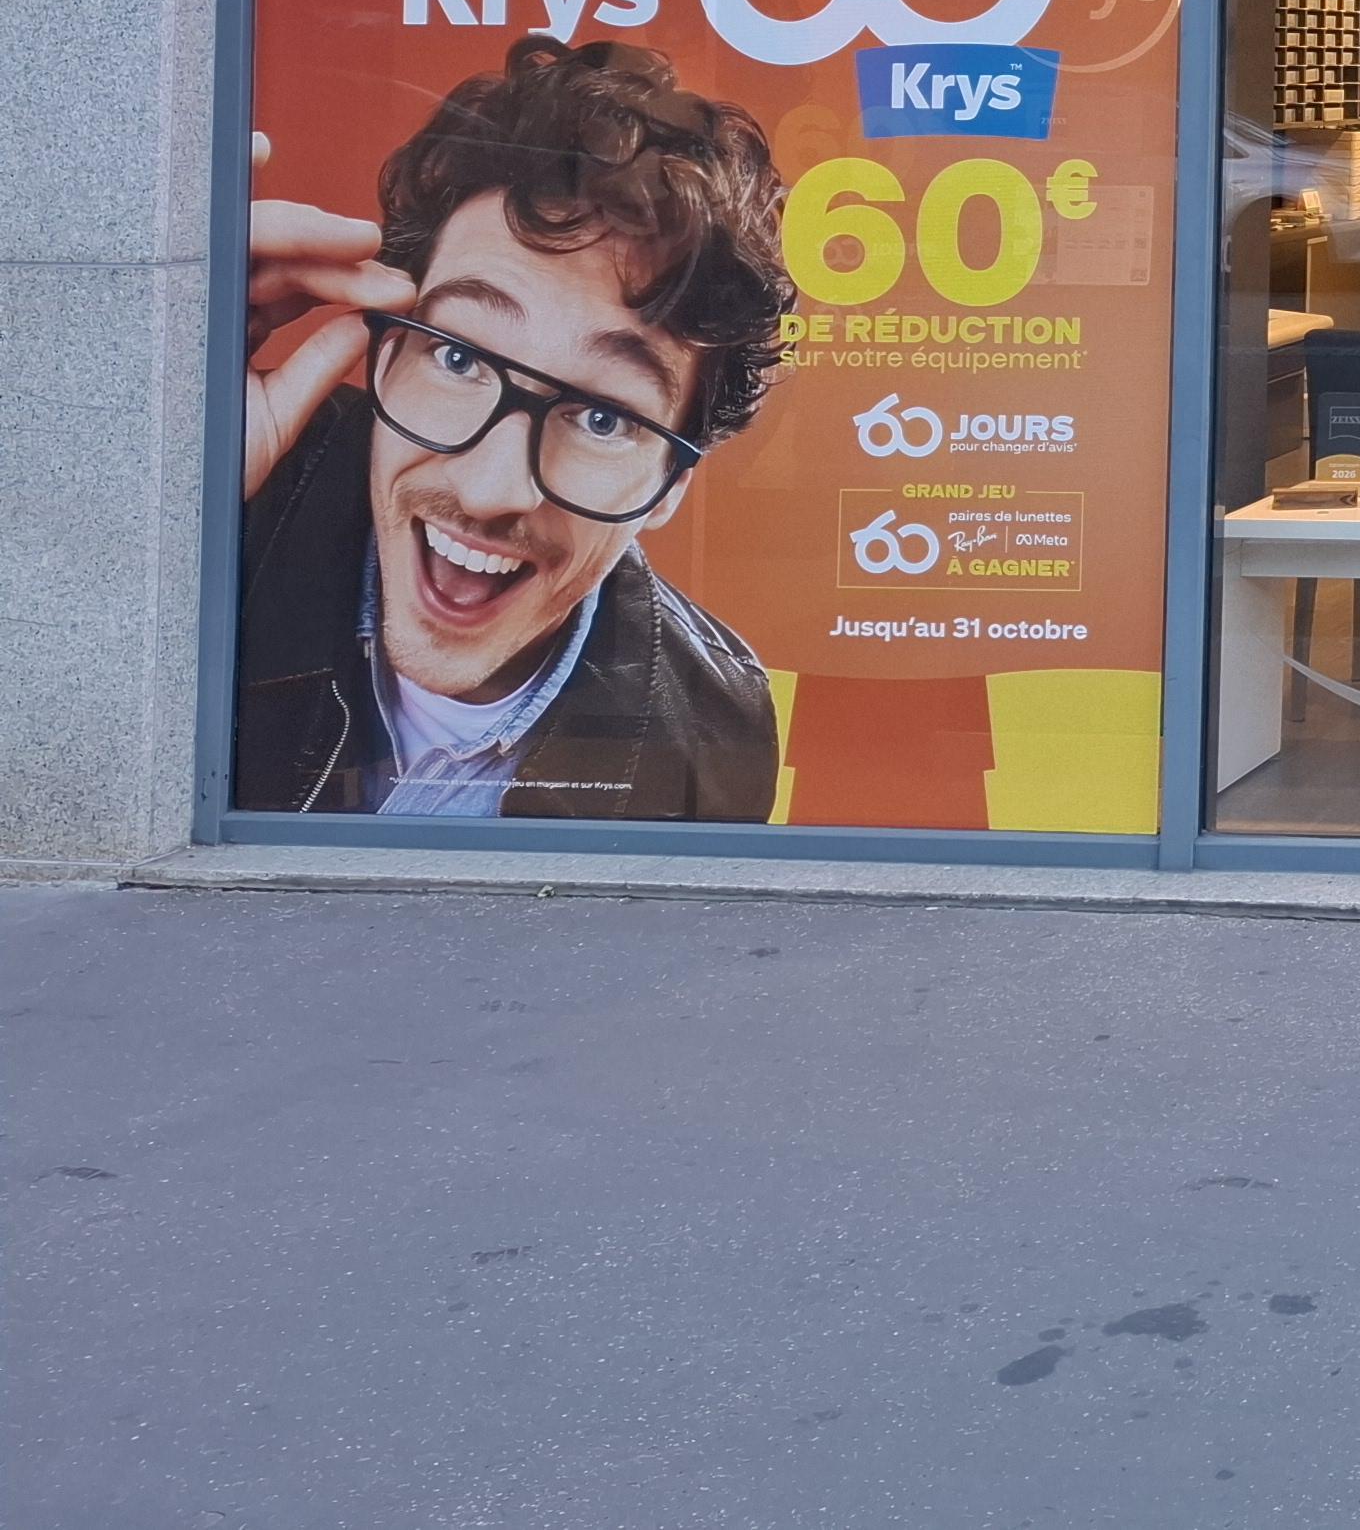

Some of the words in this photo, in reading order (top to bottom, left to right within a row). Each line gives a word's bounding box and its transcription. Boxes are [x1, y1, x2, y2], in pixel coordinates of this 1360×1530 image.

[889, 61, 1023, 122] Krys
[779, 314, 834, 343] DE
[845, 308, 1082, 345] RÉDUCTION
[779, 349, 824, 368] sur
[832, 349, 903, 368] votre
[852, 392, 943, 458] 60
[949, 414, 1076, 441] JOURS
[949, 442, 978, 454] pour
[981, 441, 1034, 454] changer
[902, 484, 974, 499] GRAND
[978, 484, 1016, 500] JEU
[849, 509, 940, 575] 60
[948, 511, 991, 525] paires
[994, 511, 1012, 522] de
[1015, 511, 1072, 523] lunettes
[1034, 533, 1068, 547] Meta
[946, 555, 963, 576] À
[829, 615, 946, 641] Jusqu'au
[952, 618, 981, 638] 31
[988, 618, 1087, 640] octobre
